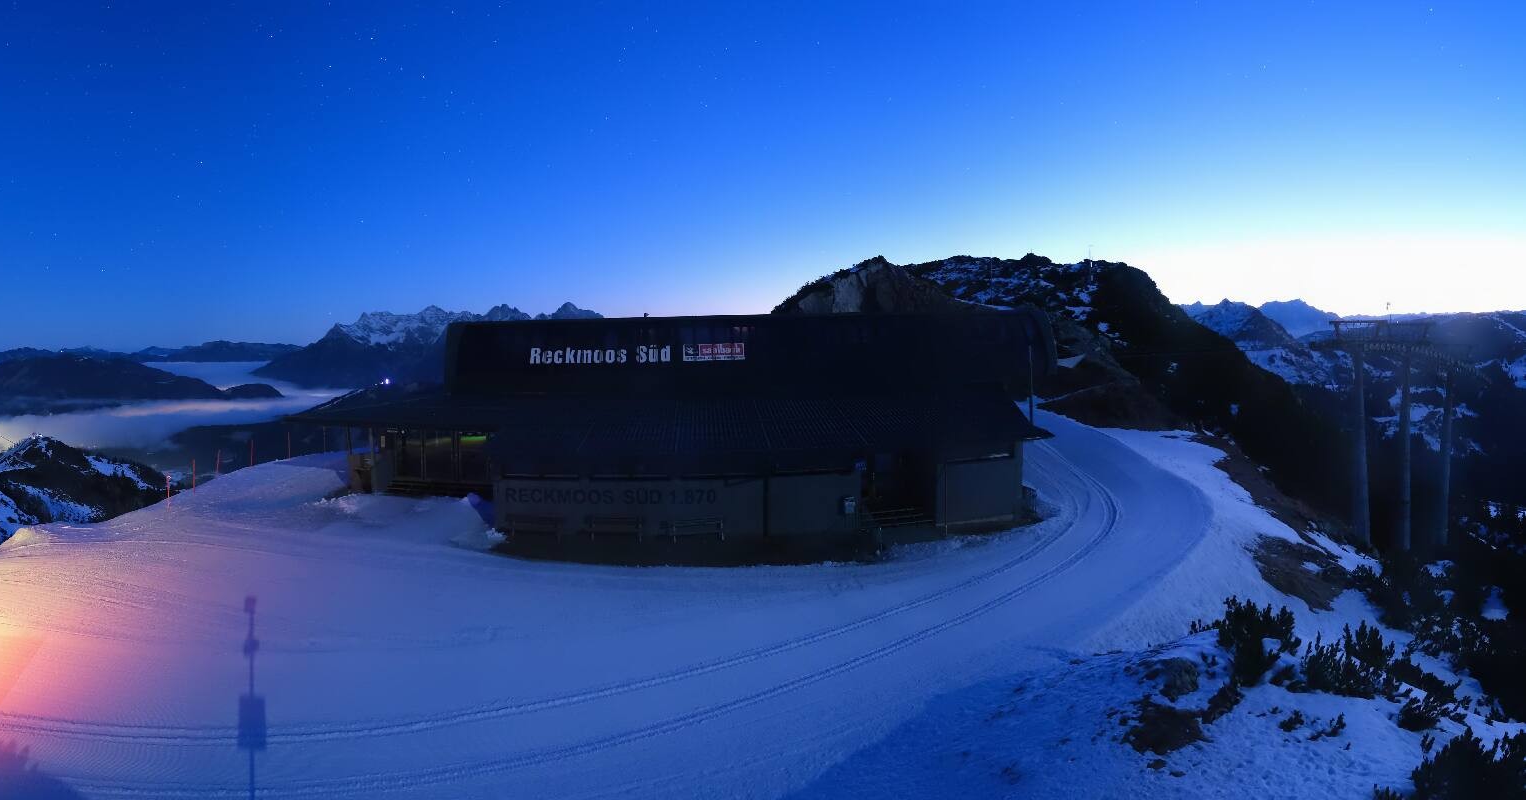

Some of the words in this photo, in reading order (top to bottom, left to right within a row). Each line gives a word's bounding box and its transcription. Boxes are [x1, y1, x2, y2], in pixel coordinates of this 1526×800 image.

[529, 347, 627, 365] Reckmoos
[636, 344, 671, 364] Süd
[505, 488, 613, 504] RECKMOOS
[624, 487, 662, 504] SÜD
[667, 489, 716, 504] 1.870
